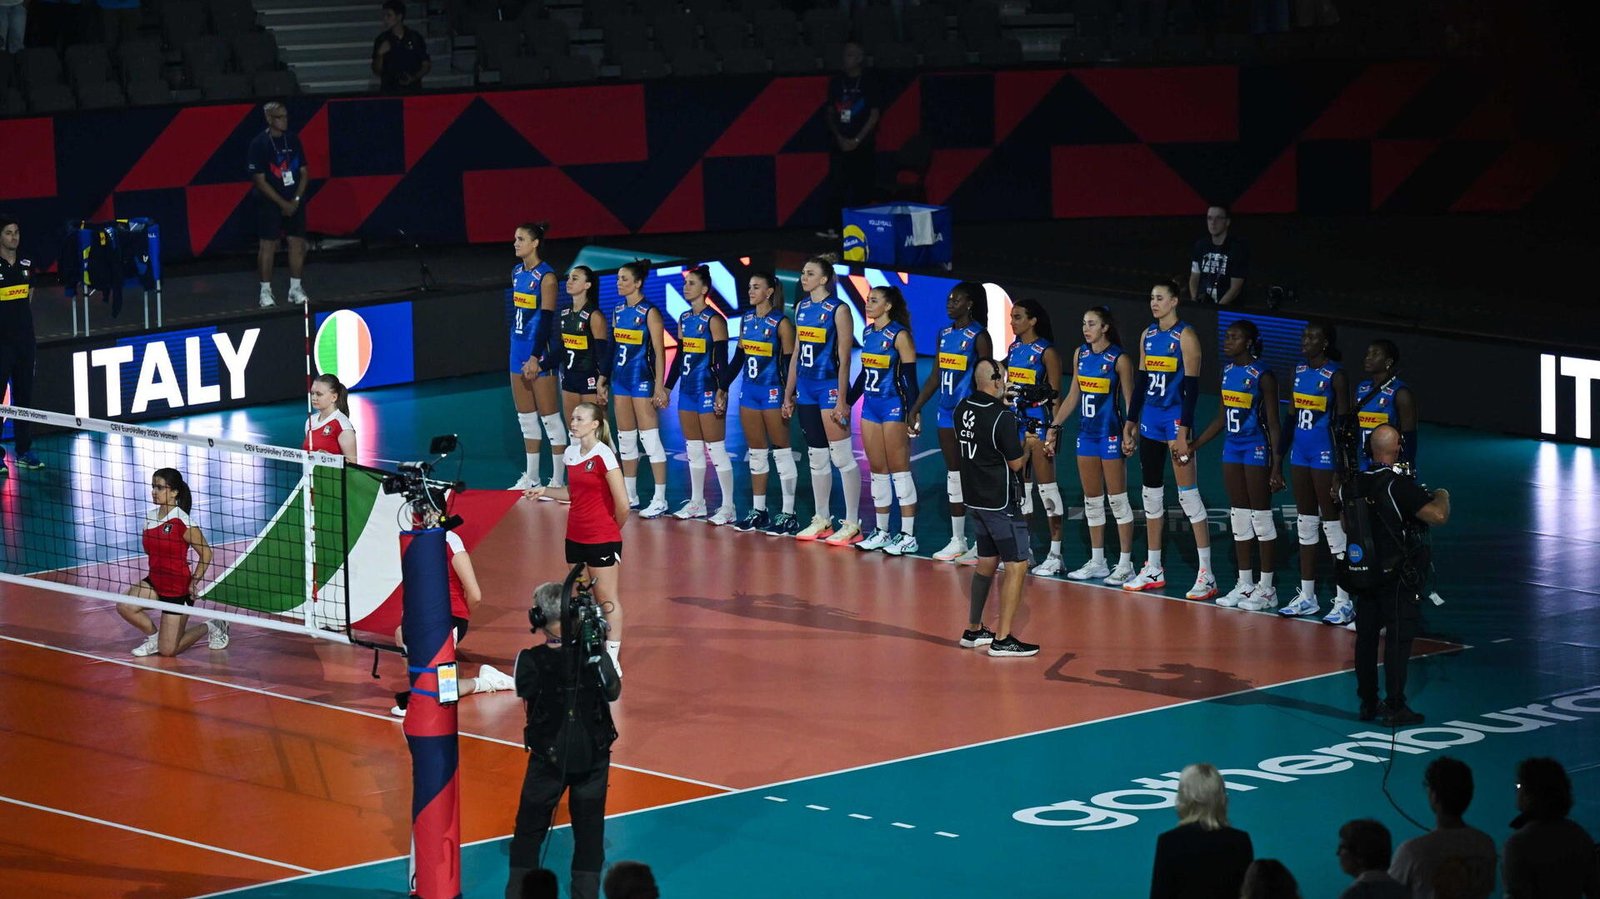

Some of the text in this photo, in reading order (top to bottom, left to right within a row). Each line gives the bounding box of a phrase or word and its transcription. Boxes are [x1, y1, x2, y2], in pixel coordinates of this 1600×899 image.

[7, 288, 28, 296] DHL
[615, 332, 631, 340] DHL
[800, 330, 816, 338] DHL
[617, 344, 627, 367] 3
[744, 344, 761, 352] DHL
[800, 344, 814, 368] 19
[567, 350, 575, 370] 7
[682, 354, 692, 376] 5
[747, 356, 758, 379] 8
[861, 357, 878, 365] DHL
[940, 357, 957, 365] DHL
[72, 327, 260, 418] ITALY
[864, 368, 880, 392] 22
[1010, 371, 1026, 379] DHL
[941, 370, 954, 396] 14
[1080, 380, 1099, 388] DHL
[1147, 373, 1167, 397] 24
[1224, 395, 1241, 403] DHL
[1295, 398, 1314, 406] DHL
[1540, 353, 1600, 439] IT
[1081, 394, 1096, 418] 16
[30, 411, 48, 420] Women
[1226, 408, 1240, 433] 15
[1297, 408, 1314, 431] 18
[110, 423, 121, 431] CEV
[121, 424, 147, 437] EuroVolley
[160, 431, 179, 440] Women
[960, 429, 975, 439] CEV
[244, 443, 255, 452] CEV
[255, 446, 281, 458] EuroVolley
[281, 449, 295, 458] 2025
[959, 439, 978, 460] TV
